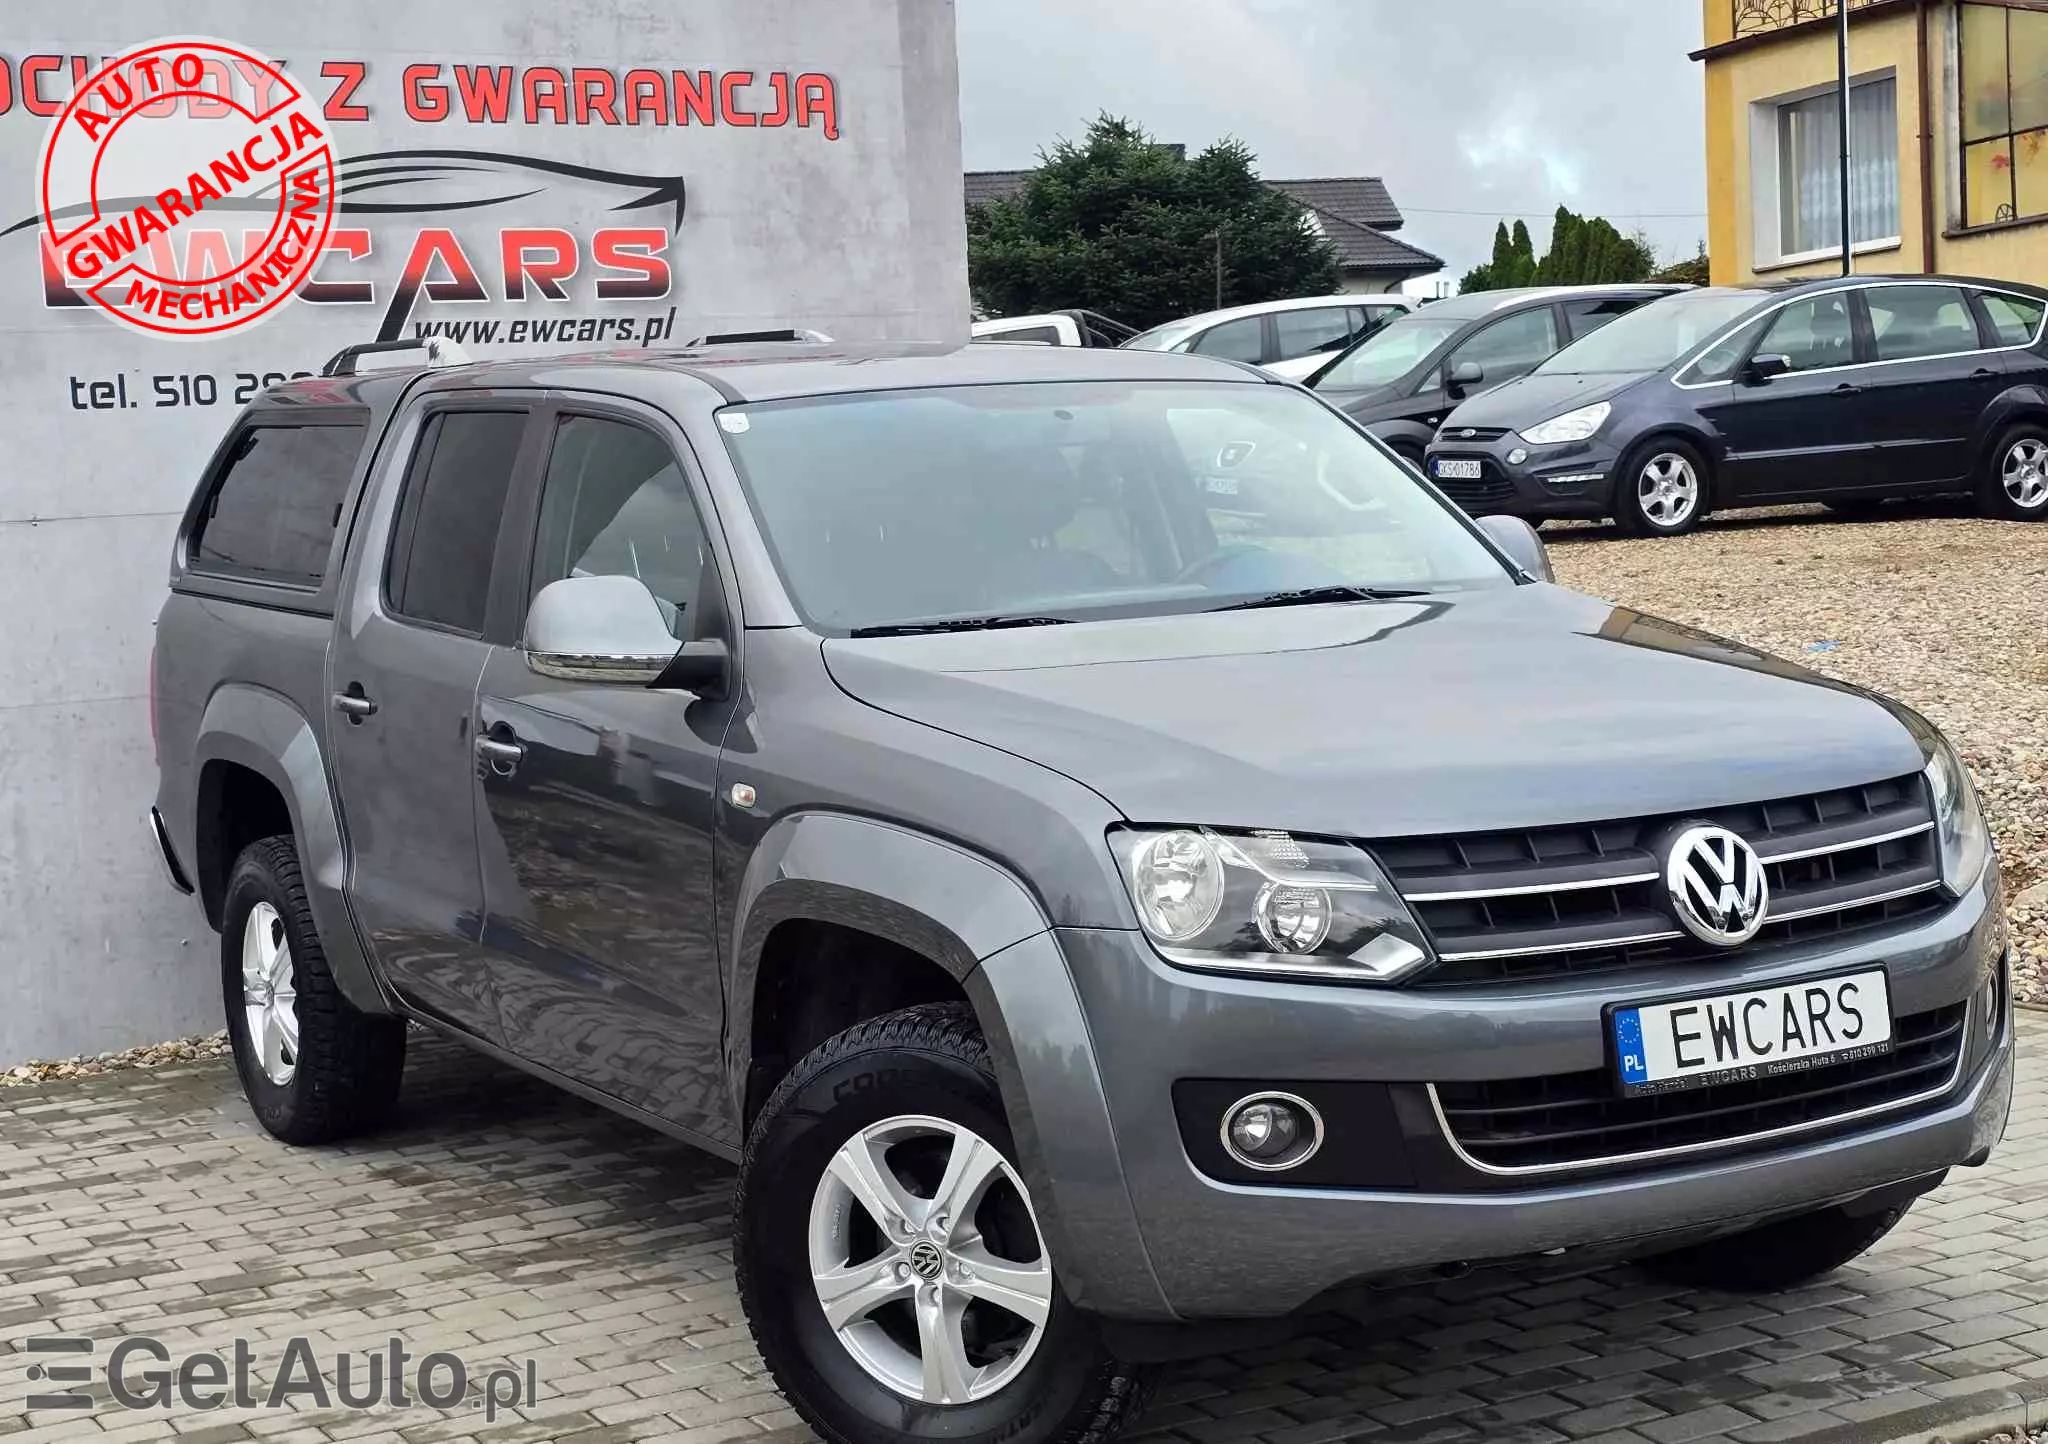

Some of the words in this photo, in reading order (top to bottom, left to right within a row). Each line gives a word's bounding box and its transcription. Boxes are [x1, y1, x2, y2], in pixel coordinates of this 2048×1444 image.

[0, 54, 286, 120] CHODY
[320, 61, 369, 121] Z
[402, 63, 840, 141] GWARANCJĄ
[38, 228, 672, 310] EWCARS
[414, 306, 678, 348] www.ewcars.pl
[69, 373, 138, 410] tel.
[152, 374, 218, 407] 510
[1670, 982, 1866, 1070] EWCARS
[1623, 1054, 1645, 1073] PL
